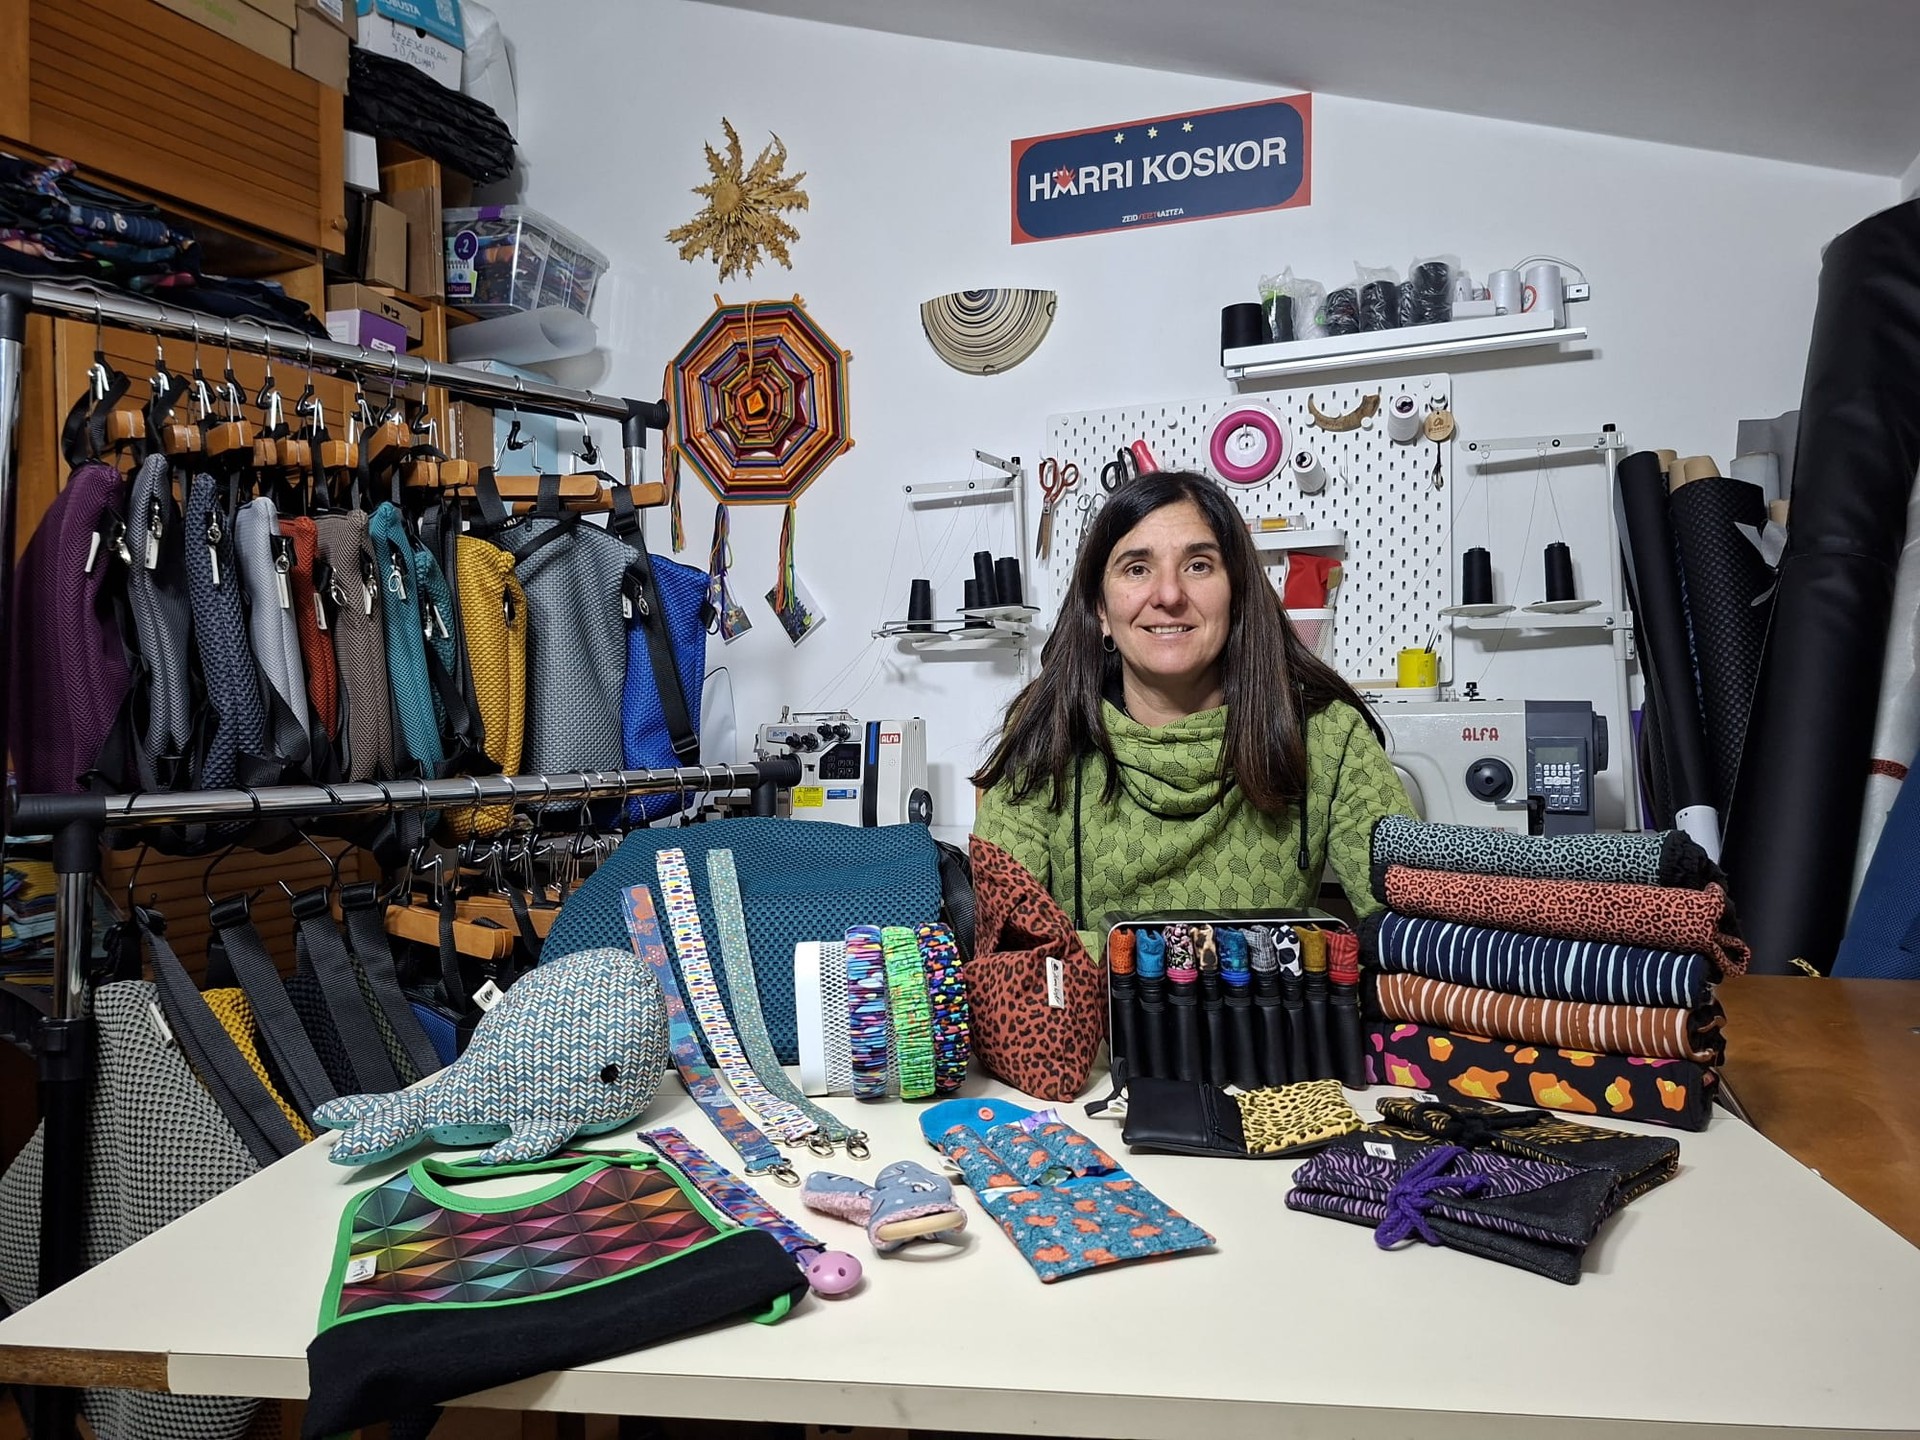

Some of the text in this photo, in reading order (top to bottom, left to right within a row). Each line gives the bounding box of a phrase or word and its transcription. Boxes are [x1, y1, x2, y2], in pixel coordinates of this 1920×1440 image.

[1029, 136, 1288, 202] HARRI KOSKOR
[1461, 727, 1499, 742] ALFA
